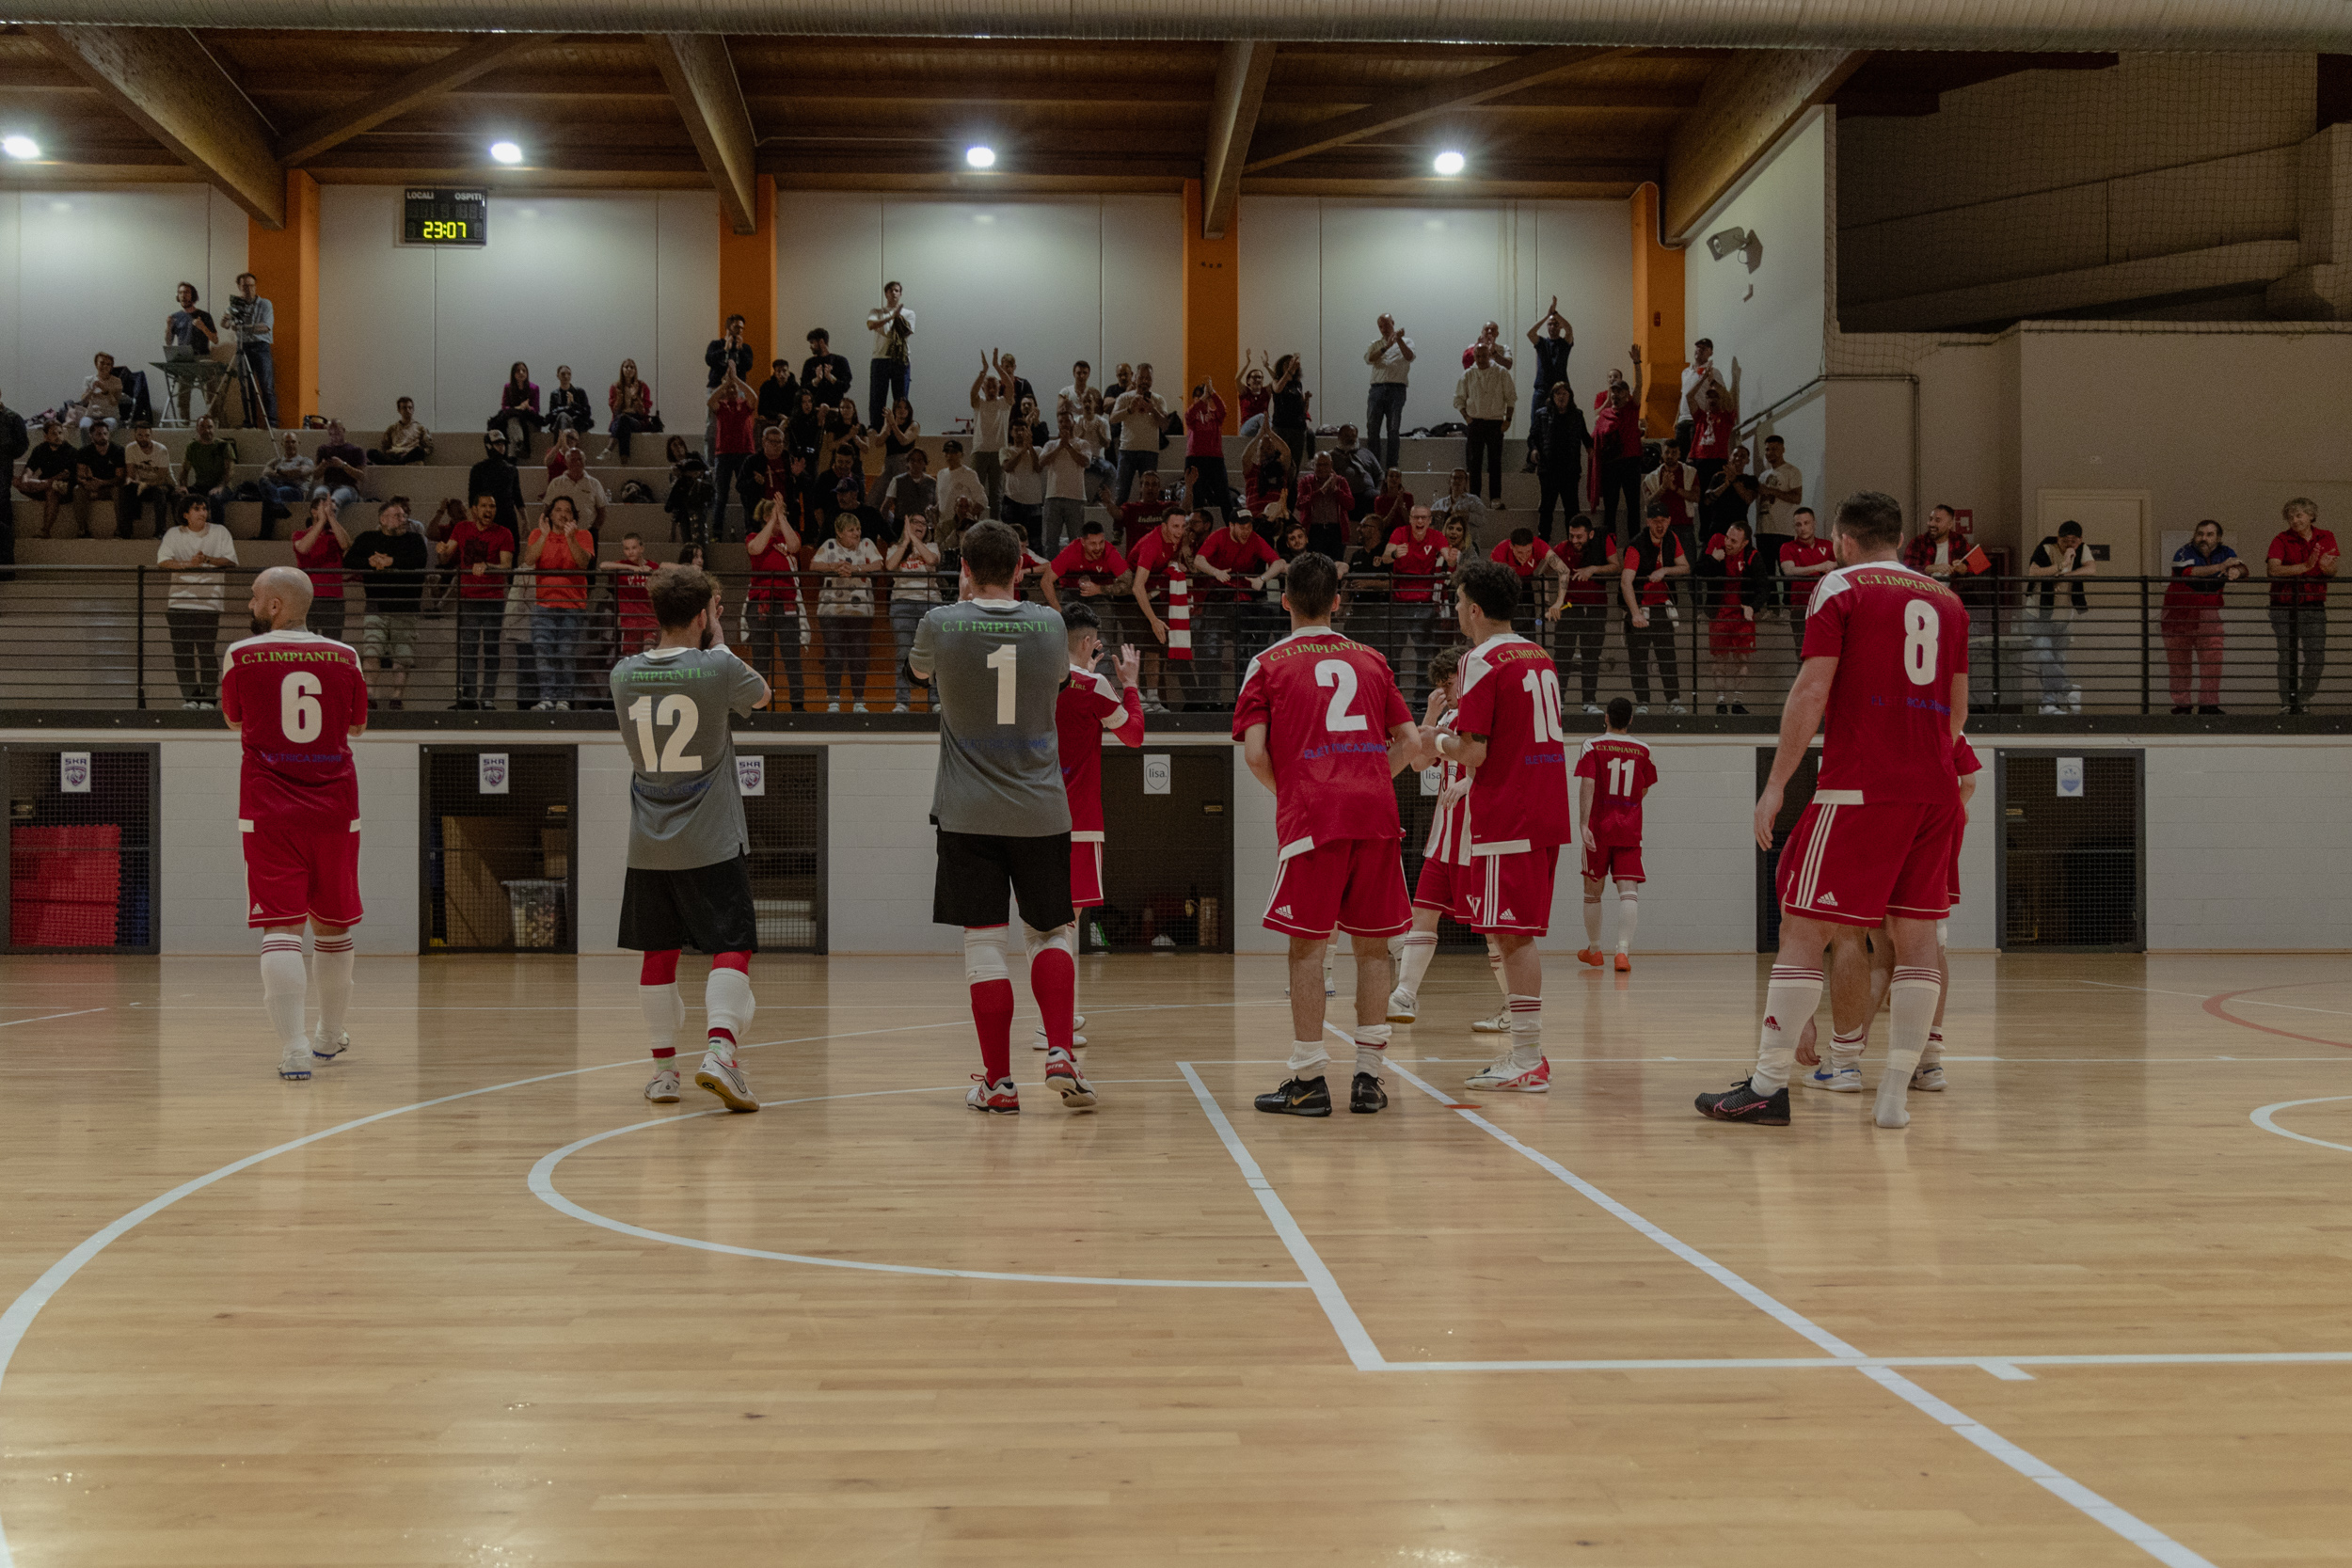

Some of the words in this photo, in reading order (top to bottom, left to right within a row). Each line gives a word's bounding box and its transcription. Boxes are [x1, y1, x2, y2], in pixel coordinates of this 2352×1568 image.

[406, 191, 435, 200] LOCALI
[454, 192, 482, 201] OSPITI
[422, 220, 468, 239] 23:07
[1904, 598, 1940, 687] 8
[280, 670, 323, 744] 6
[986, 643, 1017, 725] 1
[1314, 658, 1369, 732] 2
[1521, 669, 1565, 743] 10
[628, 693, 703, 772] 12
[1607, 757, 1635, 798] 11
